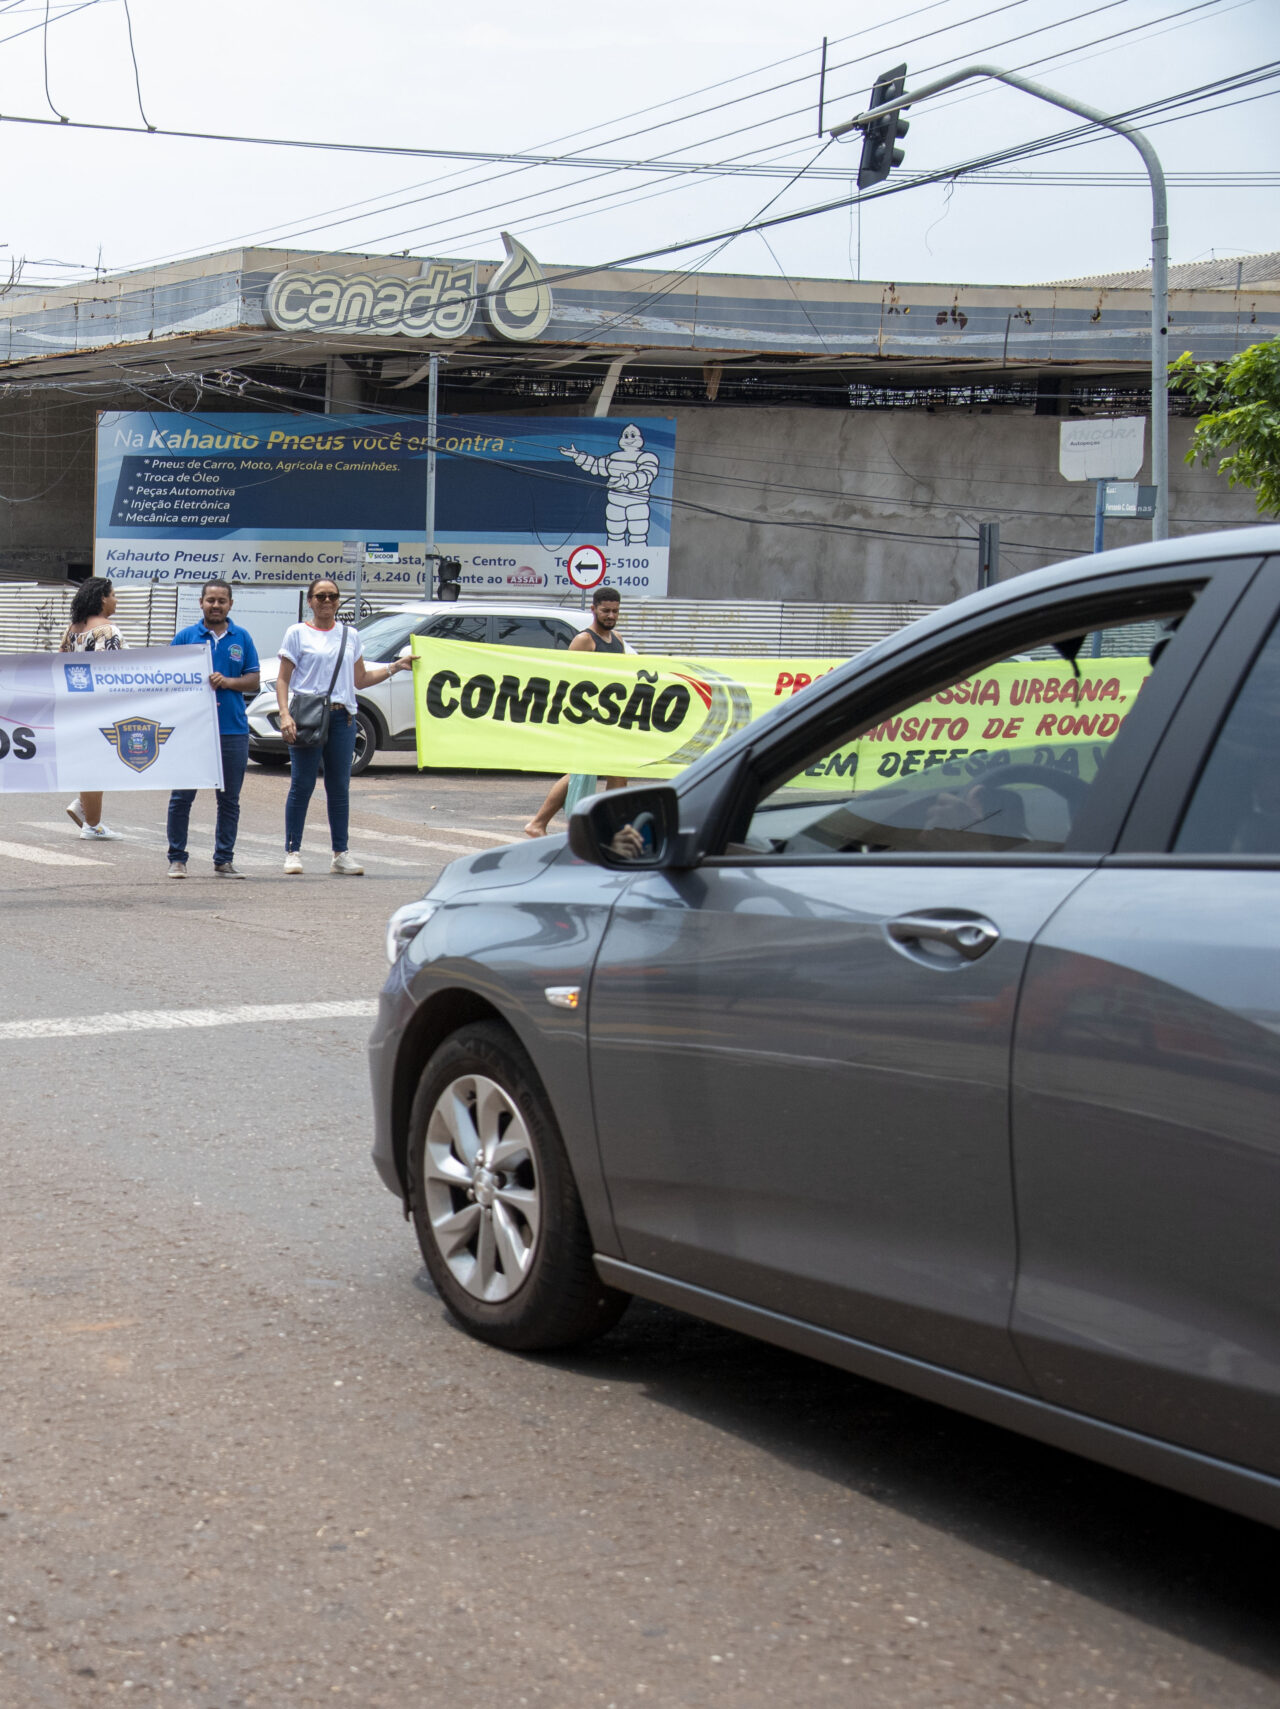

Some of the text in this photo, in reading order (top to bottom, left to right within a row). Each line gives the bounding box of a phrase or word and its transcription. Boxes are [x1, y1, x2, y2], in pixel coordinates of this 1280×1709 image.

[114, 429, 144, 448] Na
[148, 429, 259, 450] Kahauto
[267, 430, 346, 450] Pneus
[353, 431, 403, 451] você
[151, 459, 400, 472] Pneus de Carro, Moto, Agrícola e Caminhões.
[144, 471, 220, 483] Troca de Óleo
[136, 486, 236, 498] Peças Automotiva
[130, 499, 231, 511] Injeção Eletrônica
[125, 512, 230, 525] Mecânica em geral
[106, 549, 170, 561] Kahauto
[174, 550, 219, 562] Pneus
[232, 552, 252, 563] Av.
[255, 552, 314, 563] Fernando
[472, 555, 516, 567] Centro
[105, 566, 169, 579] Kahauto
[173, 567, 218, 579] Pneus
[231, 569, 251, 580] Av.
[254, 569, 321, 581] Presidente
[325, 570, 370, 583] Médii,
[373, 571, 411, 583] 4.240
[487, 574, 503, 584] ao
[95, 670, 202, 685] RONDONÓPOLIS
[1009, 677, 1127, 706] URBANA,
[426, 669, 691, 733] COMISSÃO
[122, 724, 152, 732] SETRAT
[982, 717, 1024, 739] DE
[805, 752, 859, 777] EM
